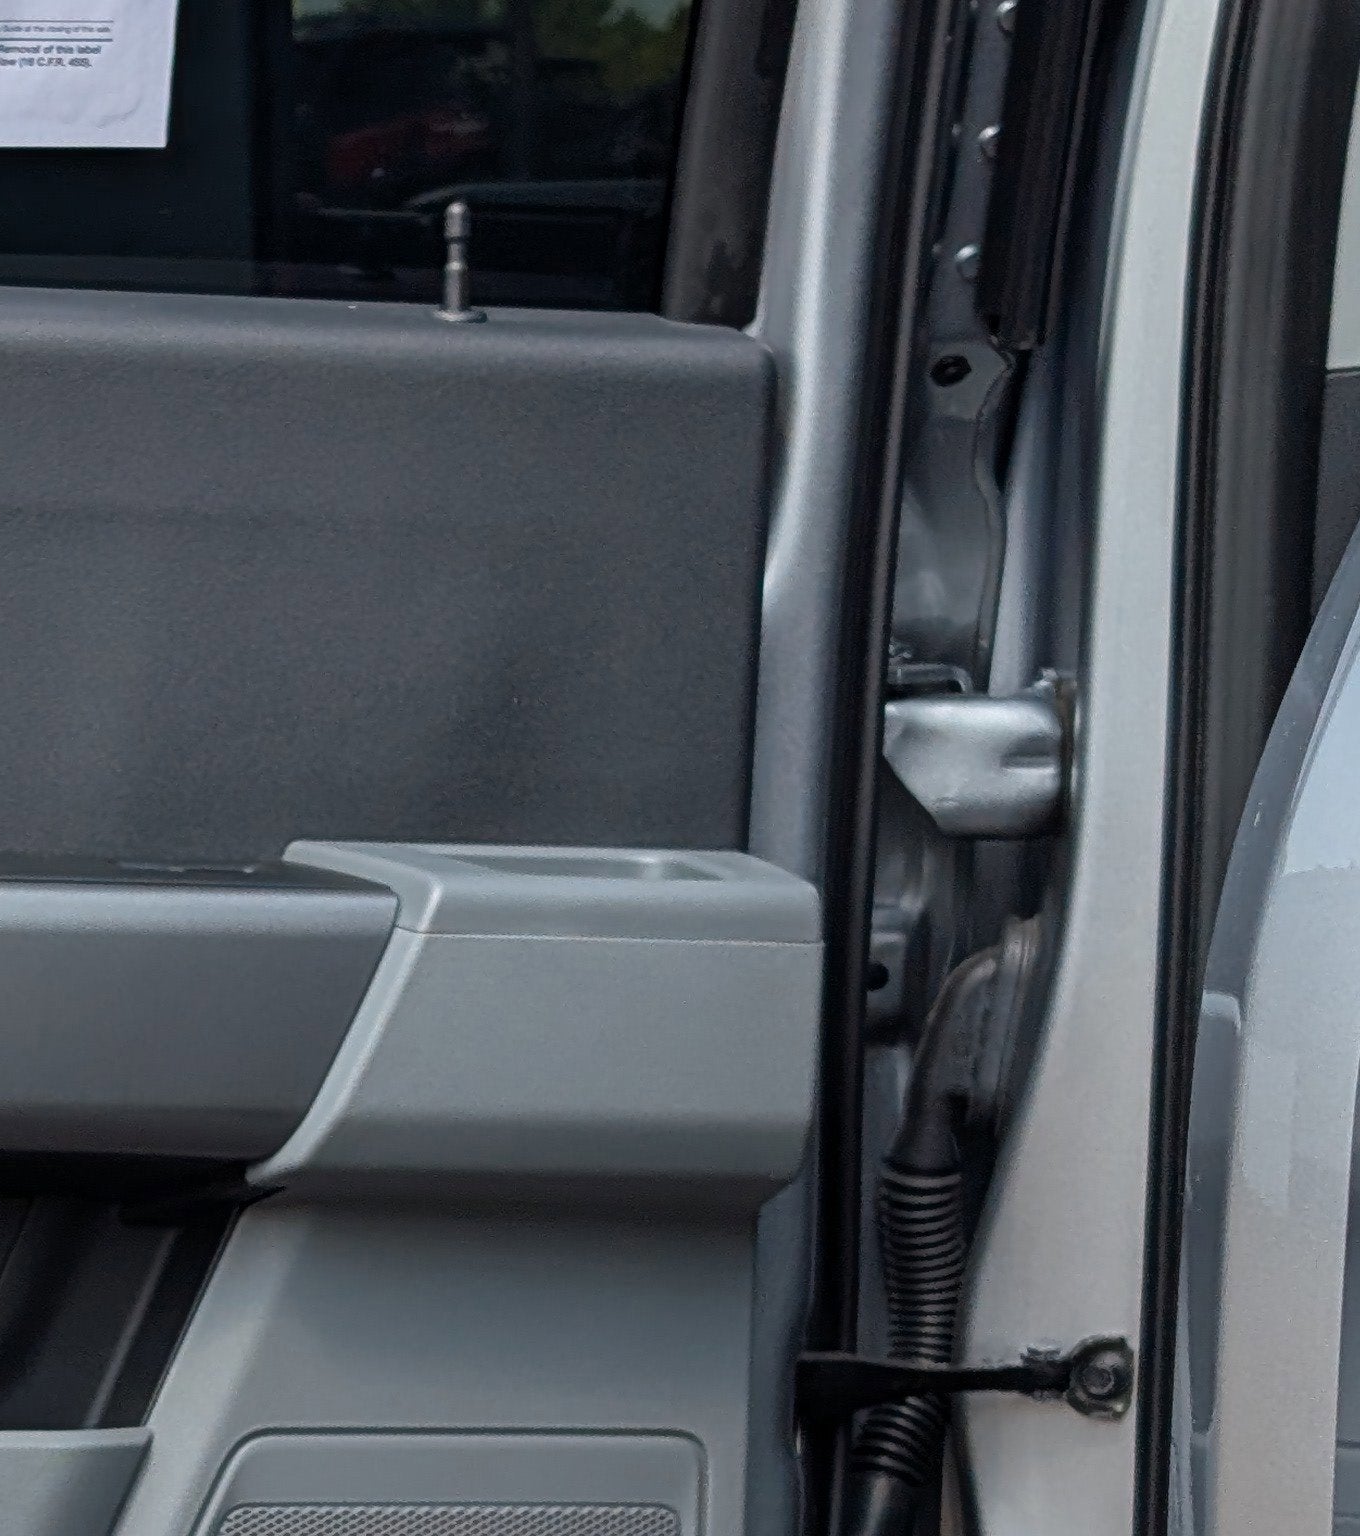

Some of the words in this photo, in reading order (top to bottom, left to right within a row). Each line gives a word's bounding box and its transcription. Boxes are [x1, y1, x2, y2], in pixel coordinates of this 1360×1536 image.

[43, 46, 54, 54] of
[56, 46, 74, 54] this
[77, 46, 102, 54] label
[0, 58, 16, 66] law
